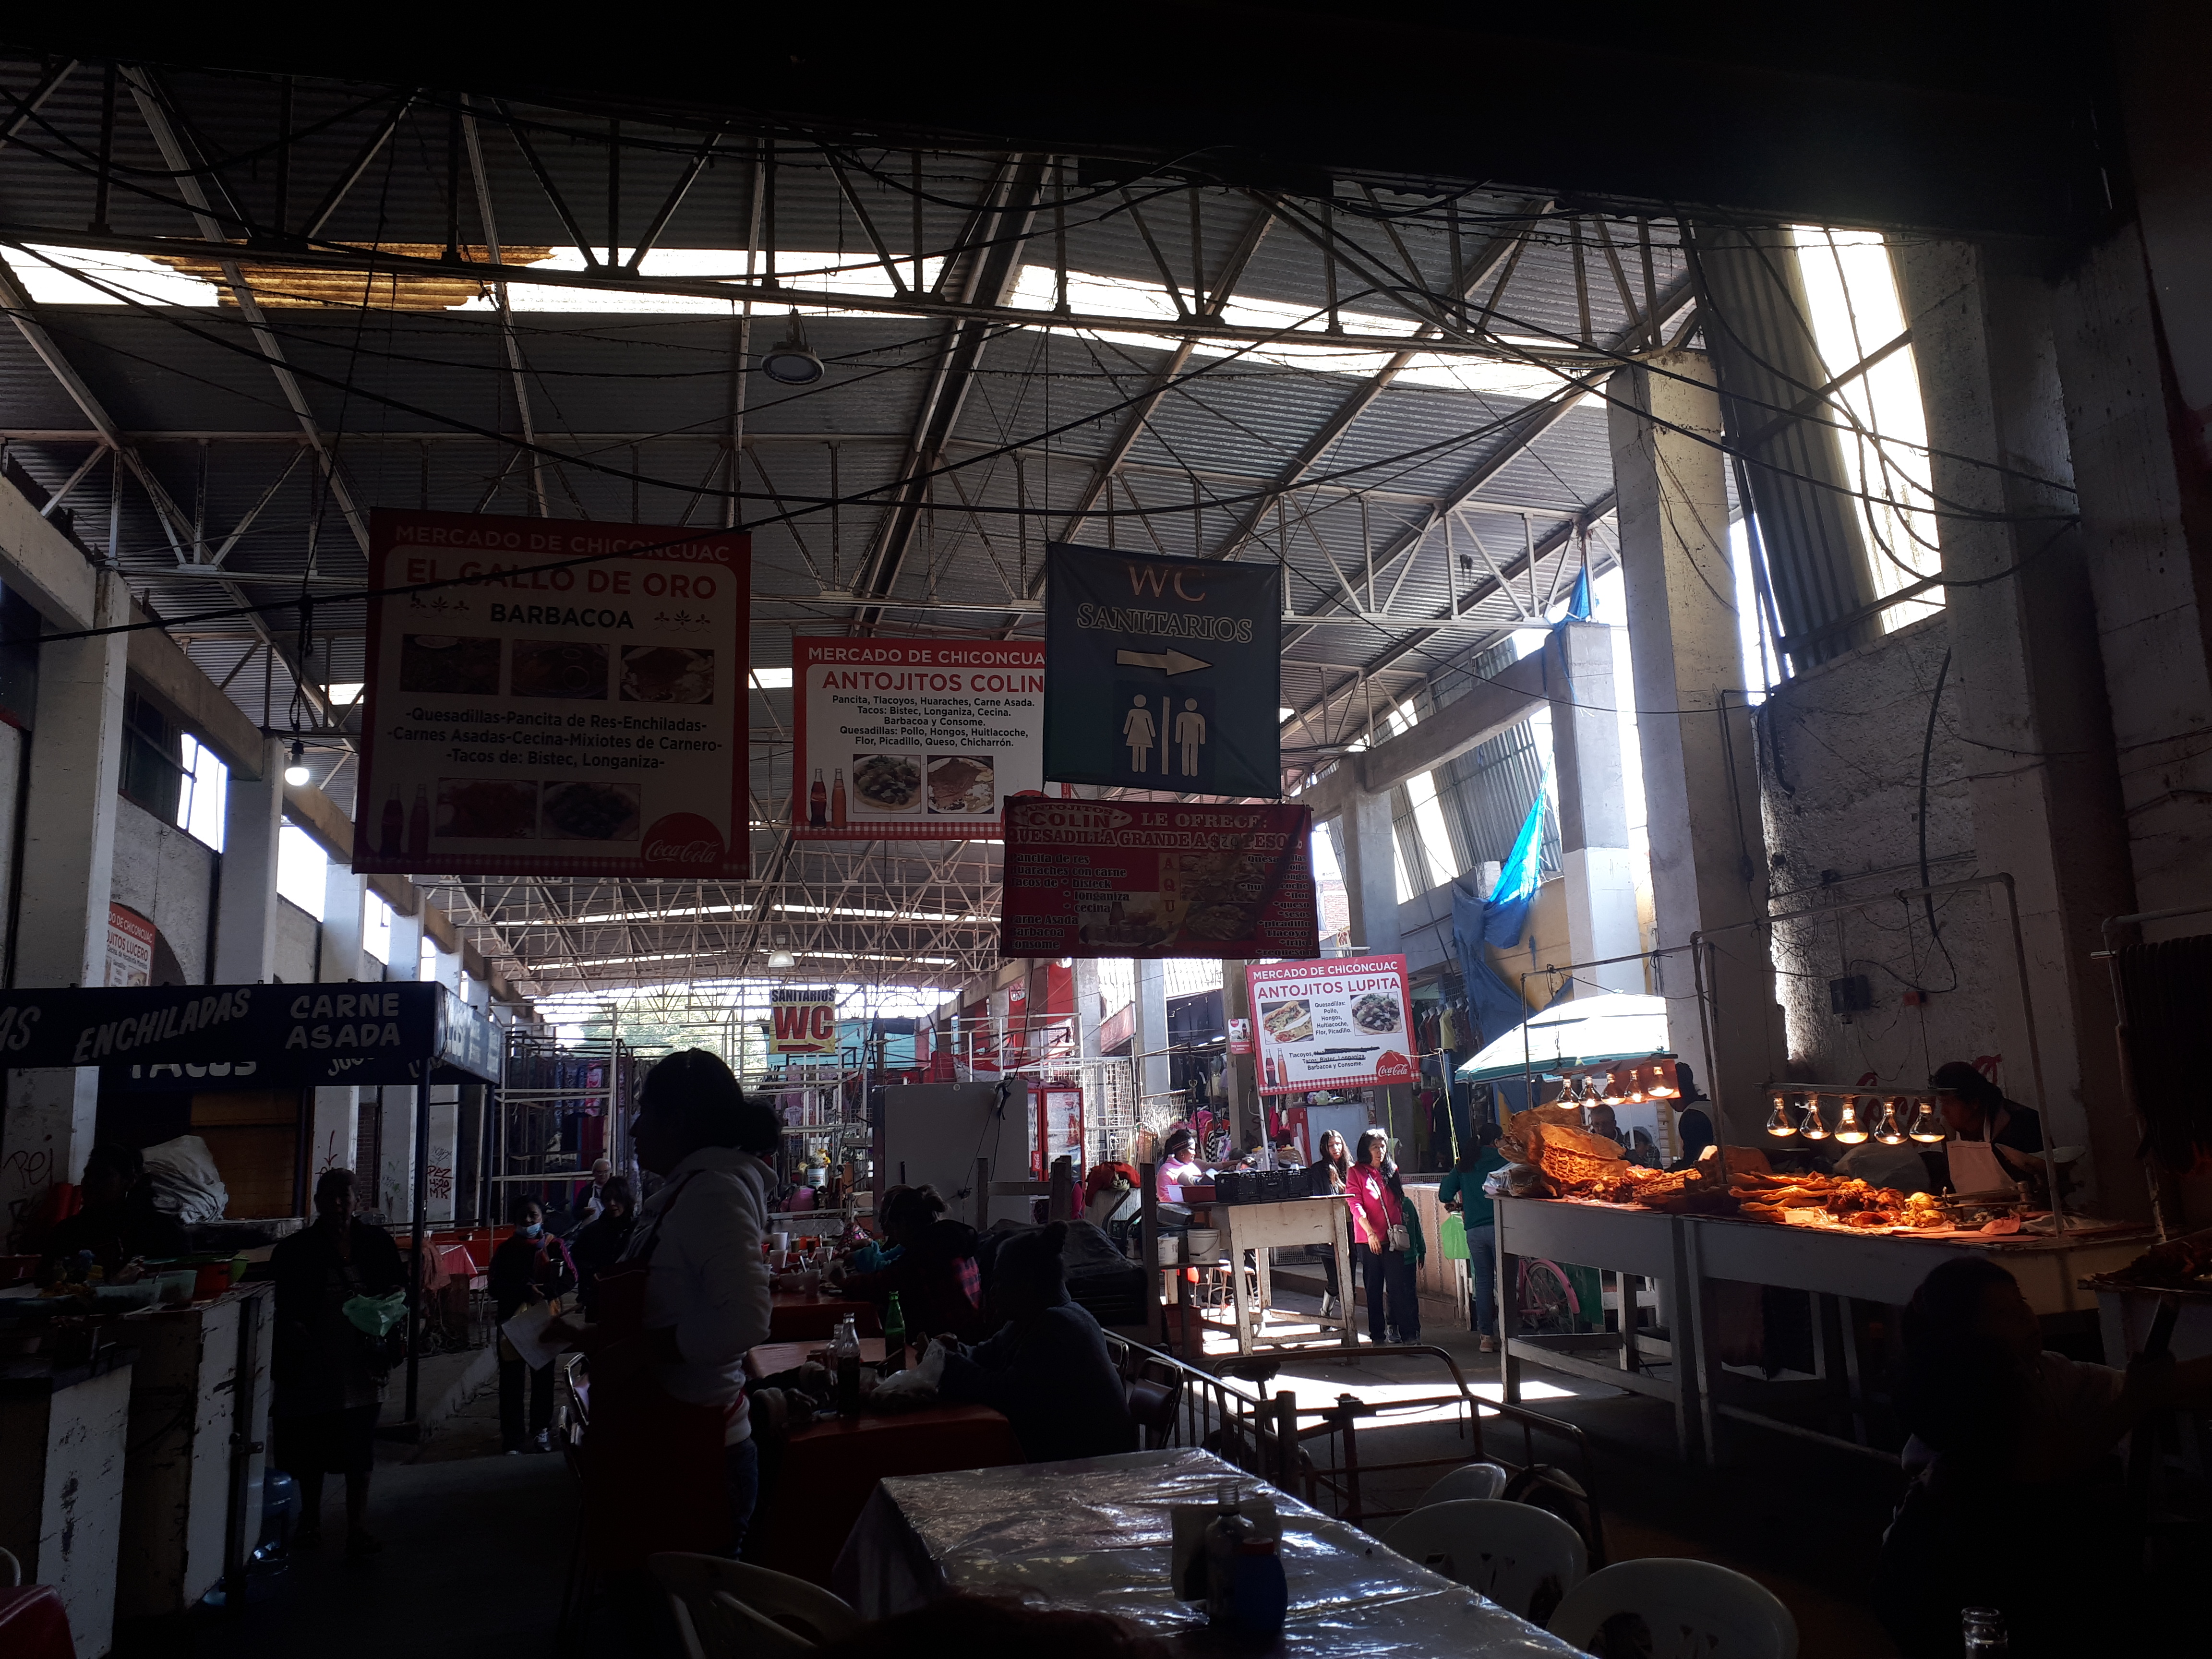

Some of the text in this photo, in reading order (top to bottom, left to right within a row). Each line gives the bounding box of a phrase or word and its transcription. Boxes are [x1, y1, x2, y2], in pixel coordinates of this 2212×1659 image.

[395, 525, 730, 562] MERCADO DE CHICONCUAC
[407, 558, 717, 600] EL GALLO DE ORO
[1128, 563, 1206, 602] WC
[490, 603, 634, 629] BARBACOA
[1077, 602, 1253, 644] SANITARIOS
[808, 647, 902, 663] MERCADO
[908, 649, 932, 663] DE
[822, 671, 1044, 693] ANTOJITOS COLIN
[832, 695, 1035, 707] Pancita, Tlacoyos, Huaraches, Carne Asada.
[857, 706, 1011, 717] Tacos: Bistec, Longaniza, Cecina.
[566, 714, 586, 728] de
[590, 715, 708, 732] Res-Enchiladas-
[884, 716, 986, 727] Barbacoa y Consome.
[388, 727, 445, 742] -Carnes
[636, 736, 655, 749] de
[659, 737, 722, 752] Carnero-
[840, 726, 1028, 738] Quesadillas: Pollo, Hongos, Huitlacoche,
[855, 736, 1014, 747] Flor, Picadillo, Queso, Chicharrón.
[446, 747, 665, 770] -Tacos de: Bistec, Longaniza-
[1141, 812, 1167, 826] LE
[1010, 828, 1116, 845] QUESADILLA
[1119, 831, 1191, 847] GRANDE
[1192, 833, 1207, 848] A
[1010, 853, 1090, 864] Pancita de res
[1072, 867, 1092, 877] con
[1094, 868, 1127, 878] carne
[1044, 878, 1058, 887] de
[1072, 878, 1112, 889] bisteck
[1074, 890, 1129, 902] longaniza
[1074, 903, 1111, 913] cecina
[1045, 914, 1079, 925] Asada
[1010, 926, 1064, 937] Barbacoa
[1253, 961, 1398, 980] MERCADO DE CHICONCUAC
[772, 989, 835, 1002] SANITARIOS
[1258, 977, 1400, 999] ANTOJITOS LUPITA
[72, 987, 252, 1065] ENCHILADAS
[289, 993, 399, 1020] CARNE
[773, 1005, 833, 1040] WC
[1317, 1021, 1349, 1029] Huitlacoche,
[285, 1022, 401, 1050] ASADA
